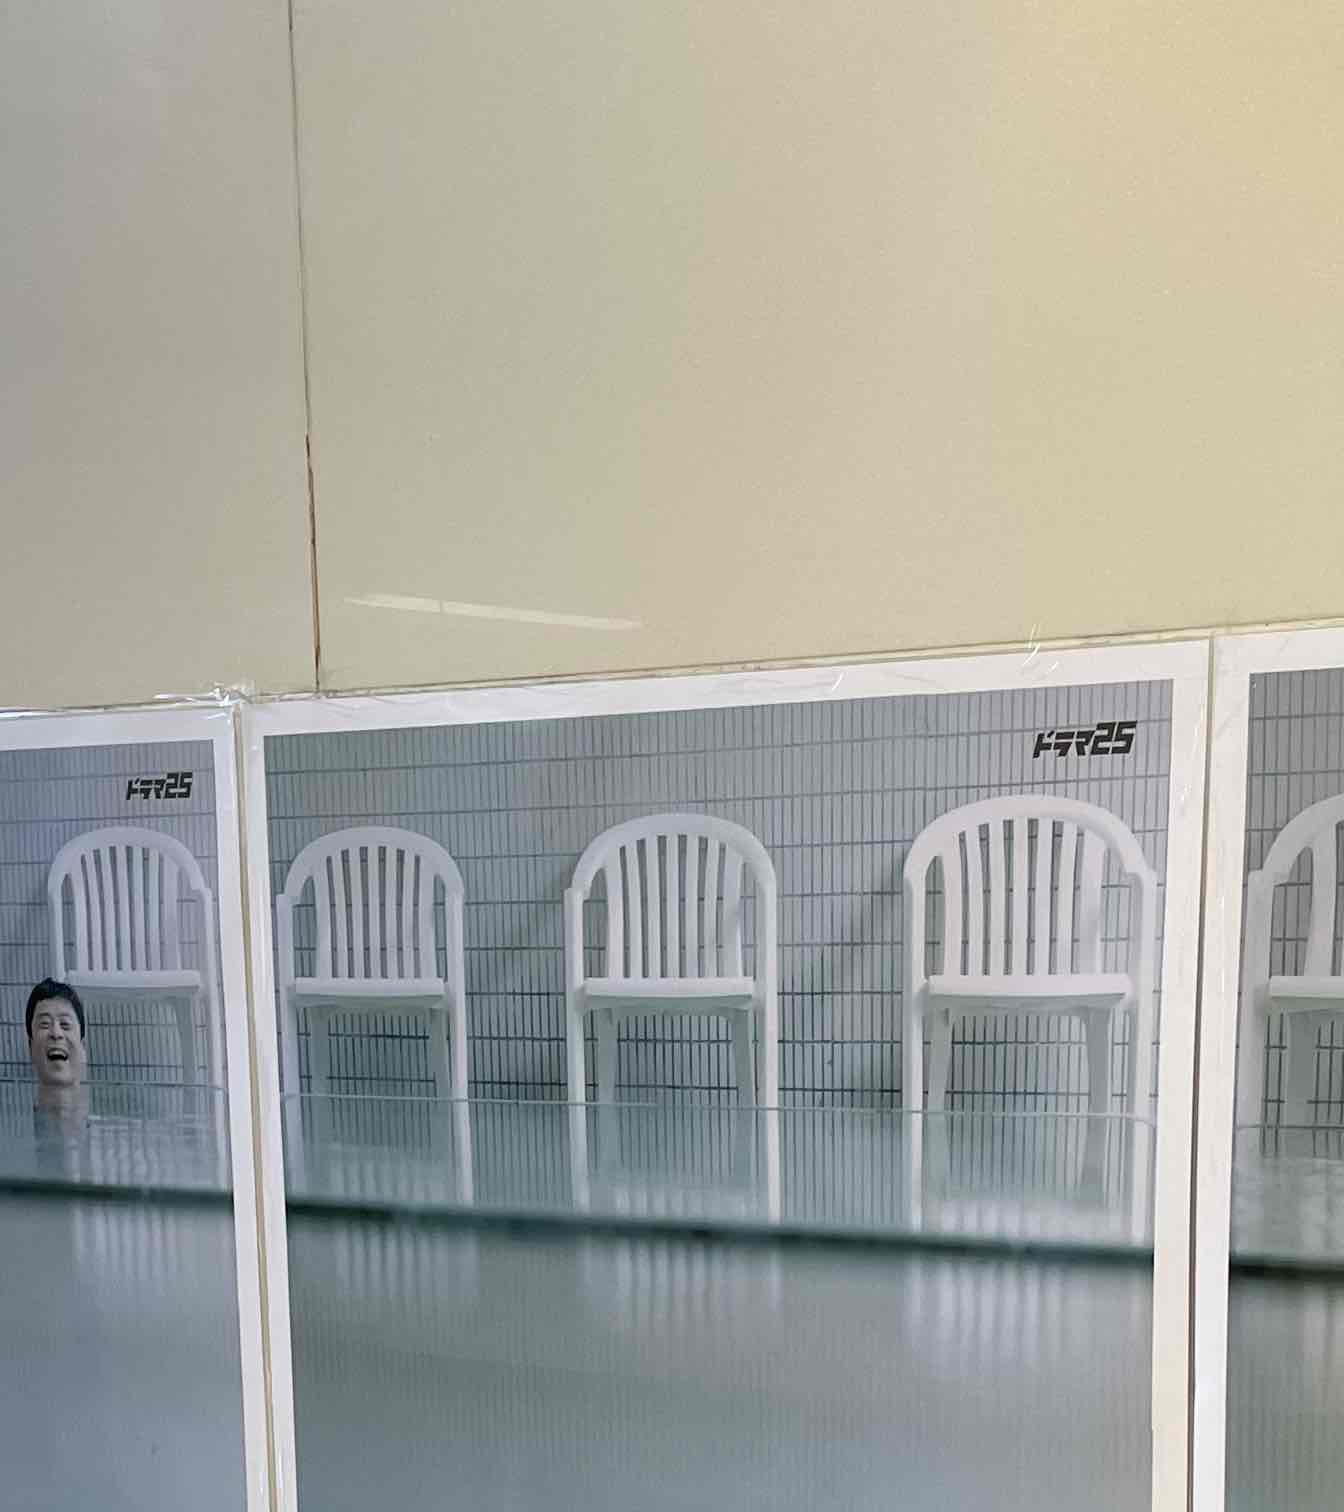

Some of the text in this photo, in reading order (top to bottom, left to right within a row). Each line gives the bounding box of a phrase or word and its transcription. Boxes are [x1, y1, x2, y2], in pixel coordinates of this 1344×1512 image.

[1033, 720, 1137, 758] ドラマ25
[126, 771, 192, 800] ドラマ25
